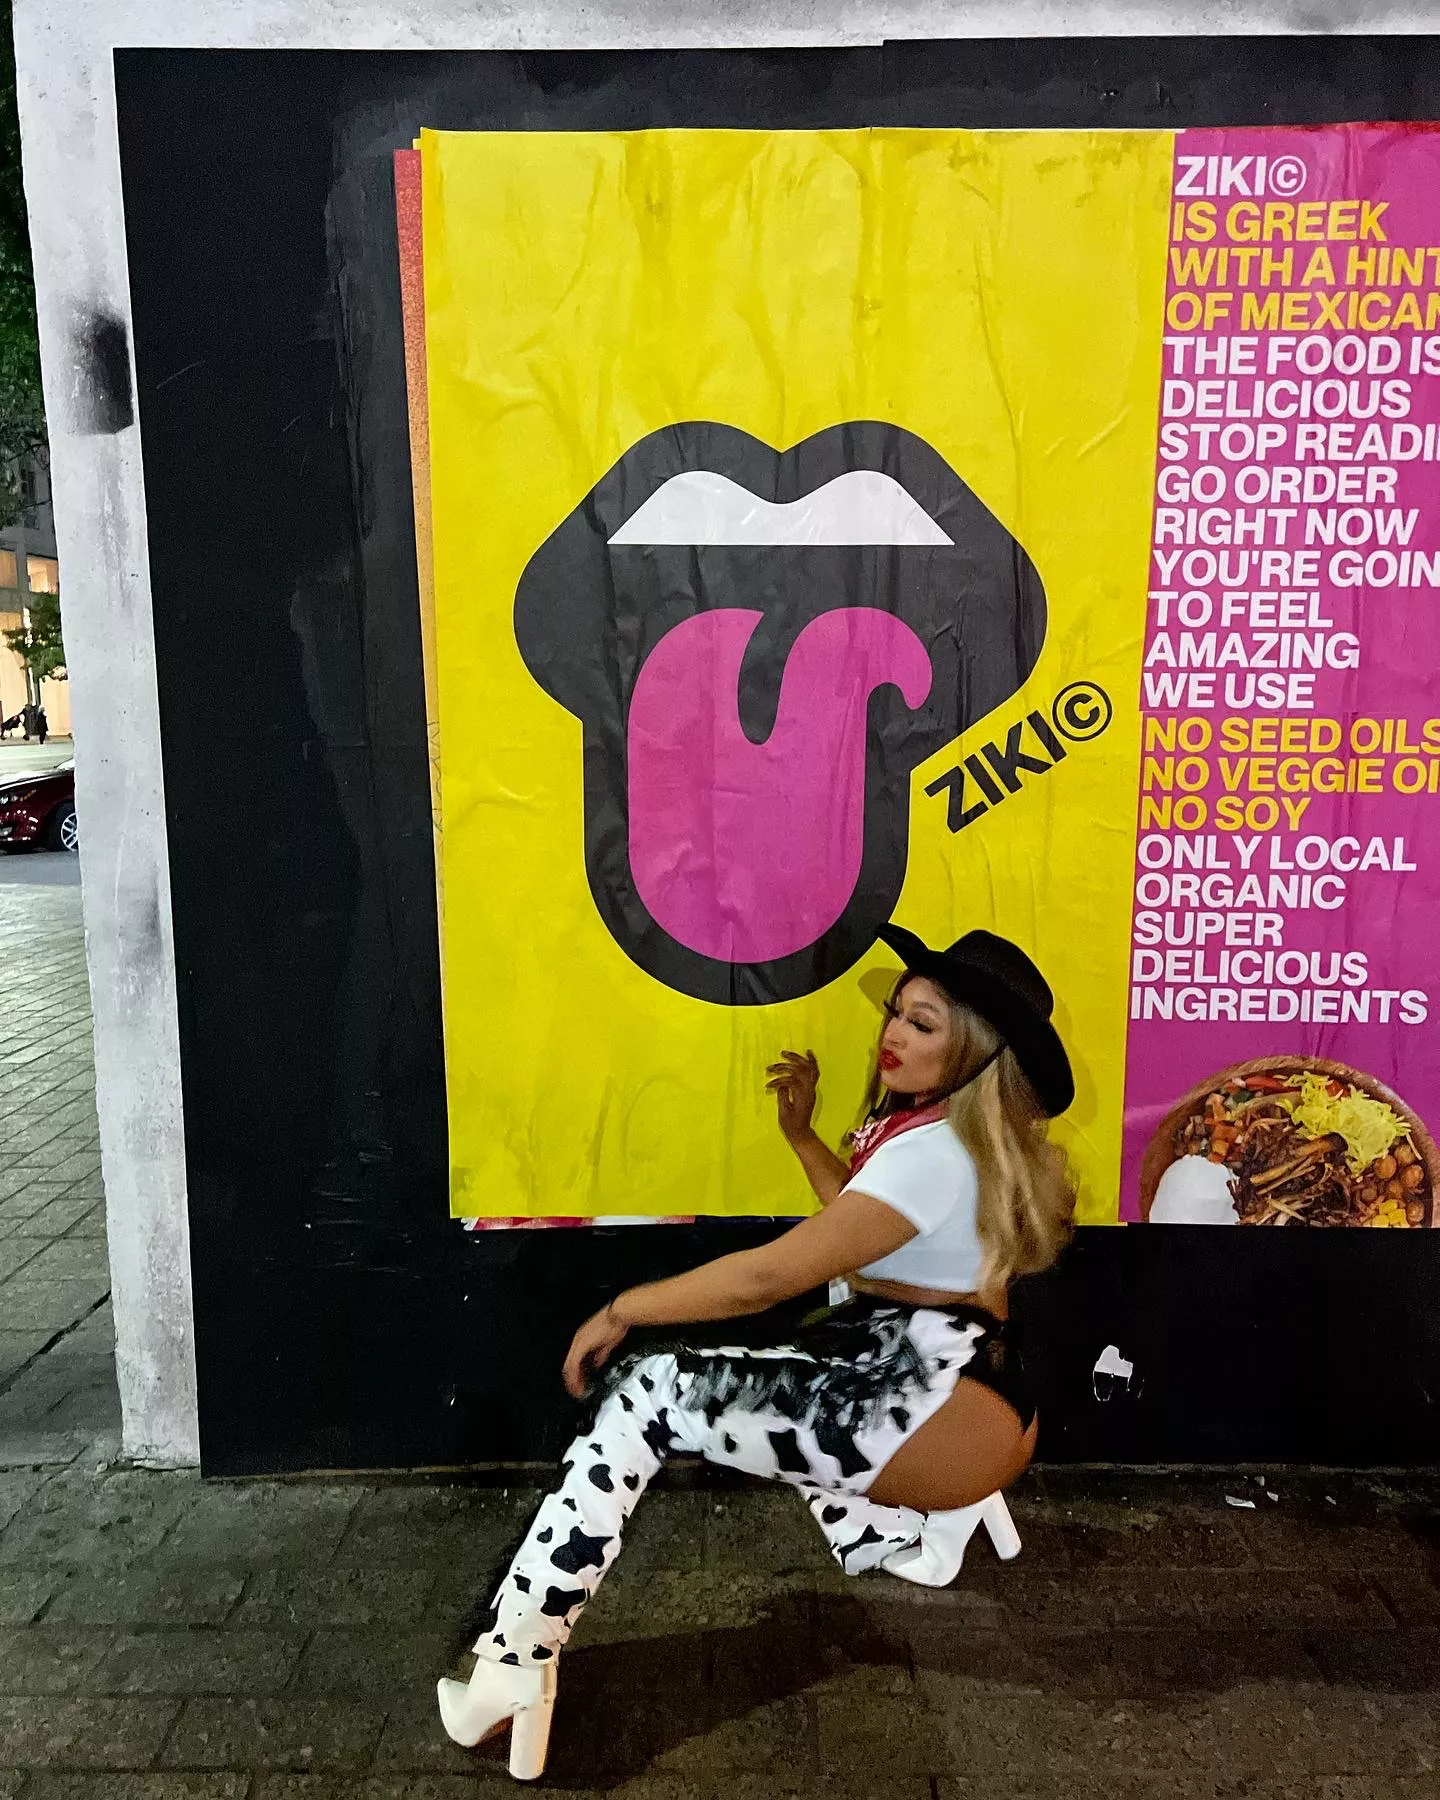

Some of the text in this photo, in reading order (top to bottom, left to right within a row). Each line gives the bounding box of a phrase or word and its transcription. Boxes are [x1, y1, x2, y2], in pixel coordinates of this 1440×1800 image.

[1172, 200, 1390, 242] IS GREEK
[1170, 247, 1294, 286] WITH
[1300, 247, 1336, 286] A
[1166, 292, 1233, 331] OF
[1162, 335, 1440, 375] THE FOOD IS
[1162, 379, 1412, 418] DELICIOUS
[1160, 423, 1440, 461] STOP READI
[1157, 466, 1398, 504] GO ORDER
[1154, 508, 1419, 546] RIGHT NOW
[1152, 550, 1321, 586] YOU'RE
[1148, 591, 1334, 628] TO FEEL
[1144, 632, 1360, 669] AMAZING
[1144, 672, 1316, 709] WE USE
[1145, 717, 1440, 754] NO SEED OILS
[1142, 756, 1210, 792] NO
[1218, 758, 1385, 793] VEGGIE
[1140, 796, 1312, 831] NO SOY
[1138, 834, 1417, 872] ONLY LOCAL
[1136, 874, 1346, 910] ORGANIC
[1134, 910, 1284, 946] SUPER
[1132, 949, 1368, 986] DELICIOUS
[1130, 986, 1428, 1024] INGREDIENTS
